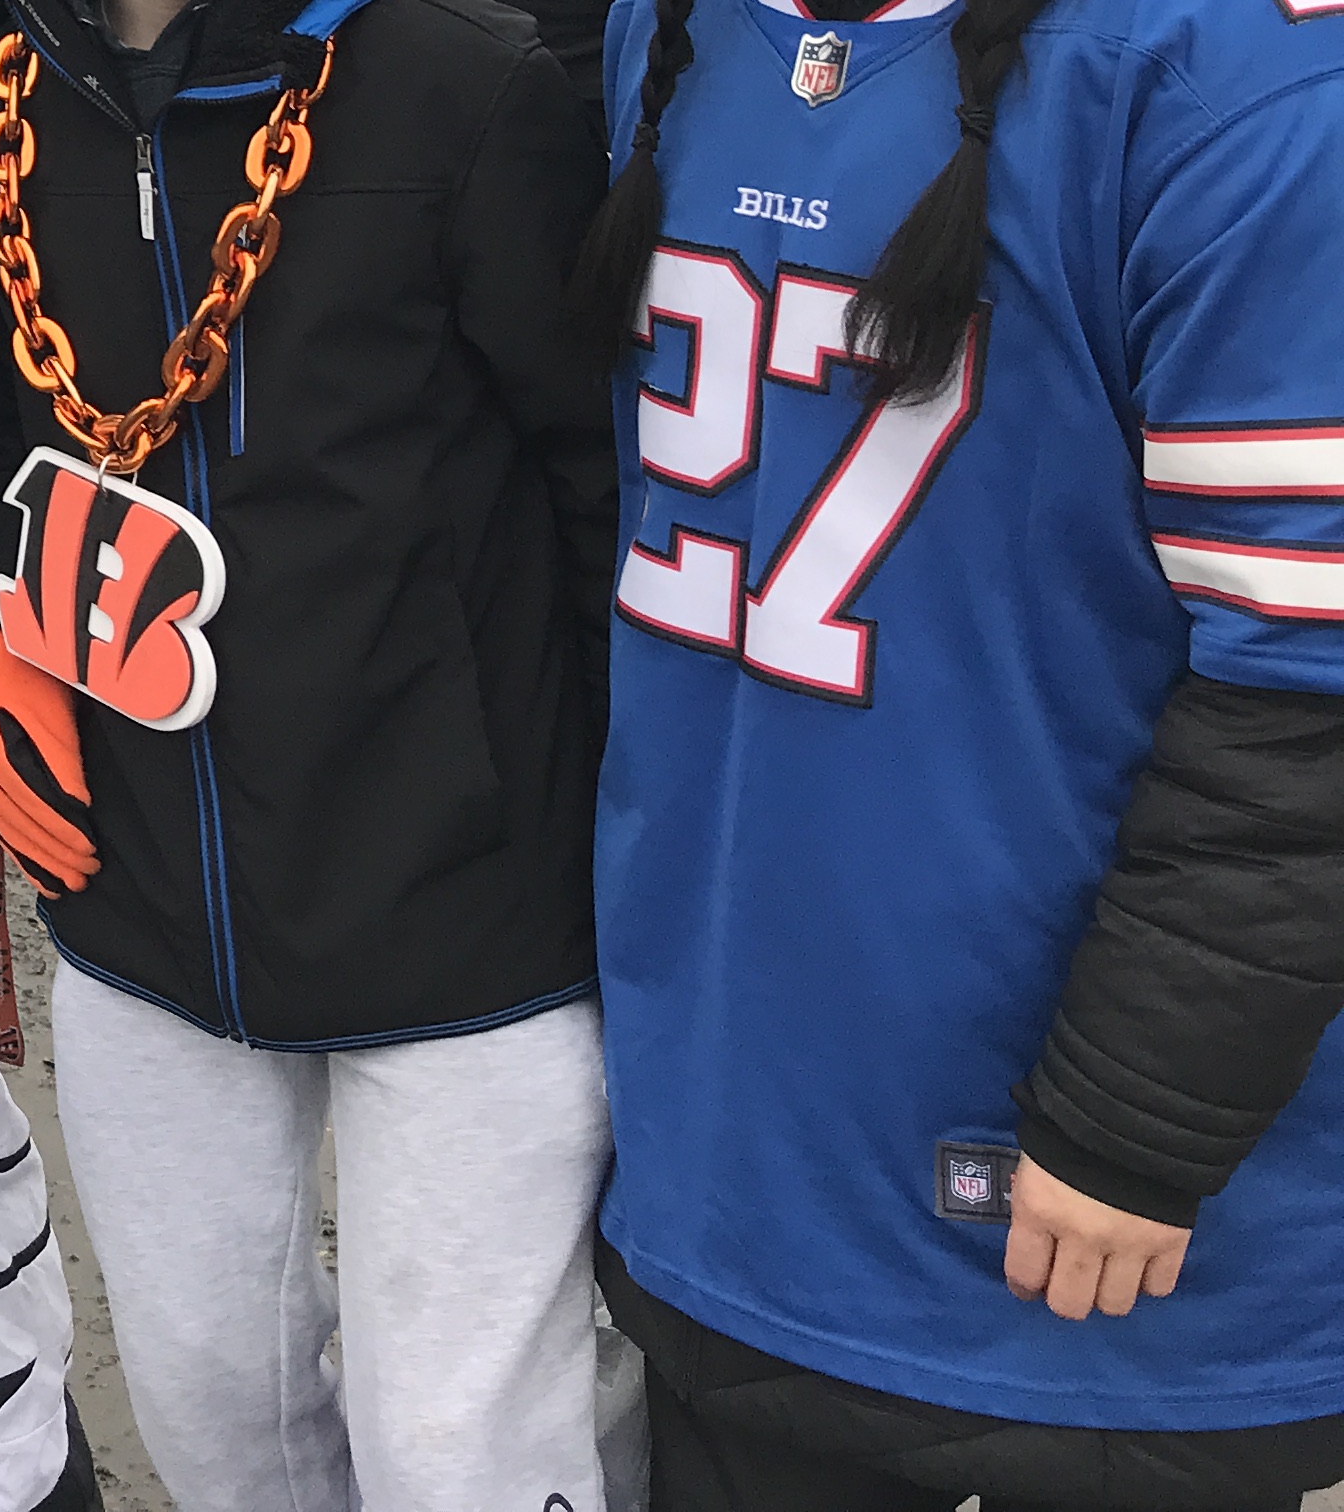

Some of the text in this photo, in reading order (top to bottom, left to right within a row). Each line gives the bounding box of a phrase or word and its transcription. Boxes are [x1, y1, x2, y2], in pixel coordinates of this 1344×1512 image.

[800, 63, 840, 93] NFL
[733, 186, 830, 230] BILLS
[615, 238, 989, 709] 27
[956, 1175, 986, 1196] NFL
